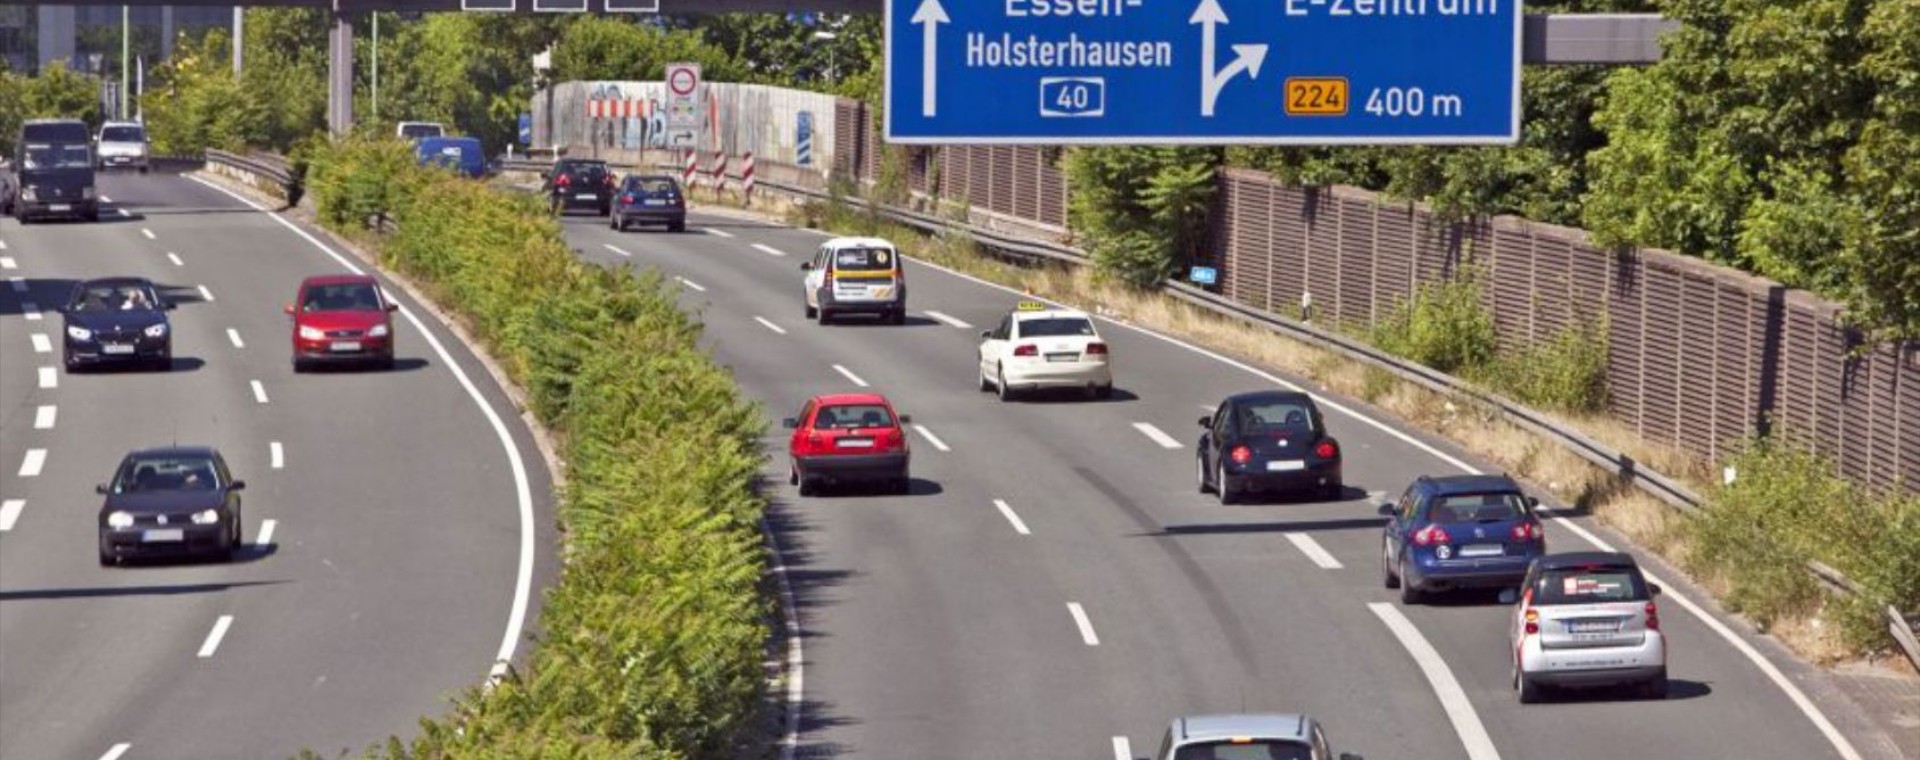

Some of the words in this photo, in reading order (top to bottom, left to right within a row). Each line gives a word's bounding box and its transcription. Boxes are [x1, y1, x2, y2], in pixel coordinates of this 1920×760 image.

[967, 33, 1171, 67] Holsterhausen
[1056, 85, 1089, 109] 40
[1293, 85, 1340, 108] 224
[1365, 87, 1424, 116] 400
[1432, 94, 1462, 116] m
